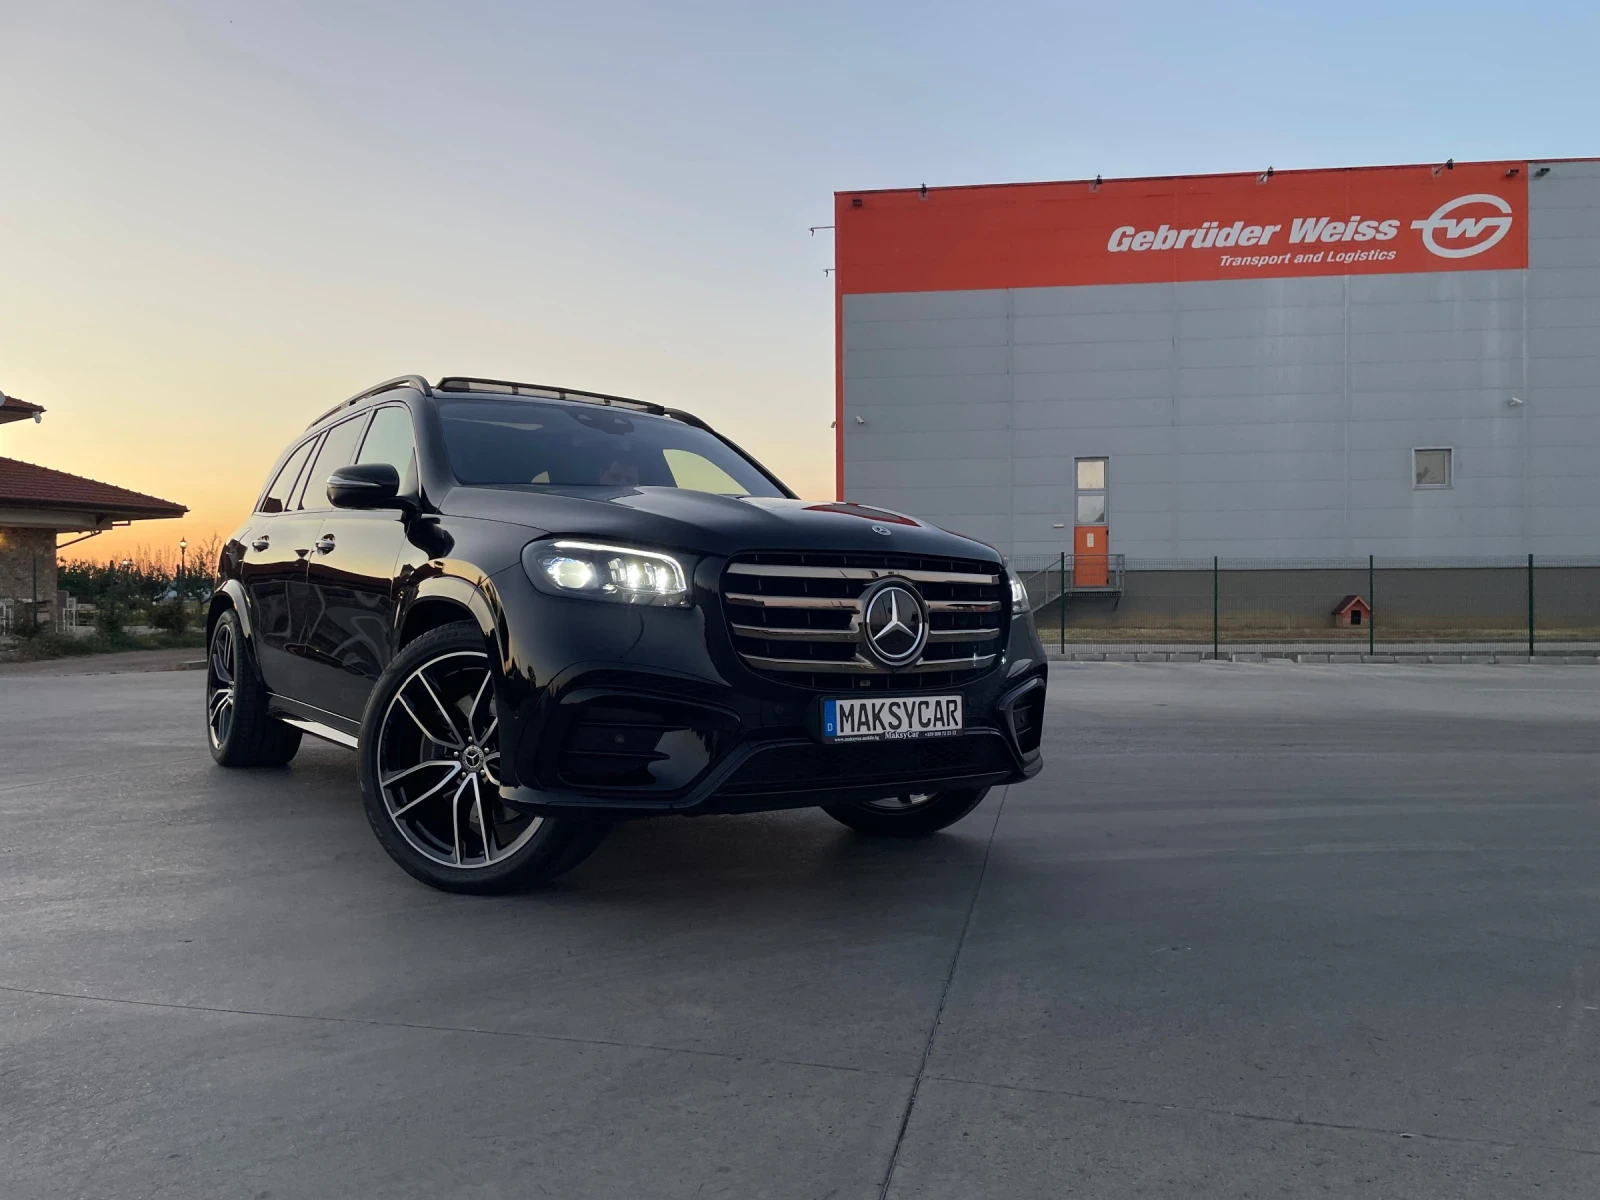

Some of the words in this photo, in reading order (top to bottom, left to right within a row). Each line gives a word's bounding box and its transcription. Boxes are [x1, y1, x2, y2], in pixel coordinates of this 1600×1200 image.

[1107, 221, 1282, 253] Gebrüder
[1288, 215, 1401, 246] Weiss
[1219, 253, 1291, 268] Transport
[1294, 251, 1325, 264] and
[1326, 249, 1398, 263] Logistics
[827, 723, 833, 732] D
[839, 699, 959, 732] MAKSYCAR
[884, 730, 920, 740] MaksyCar
